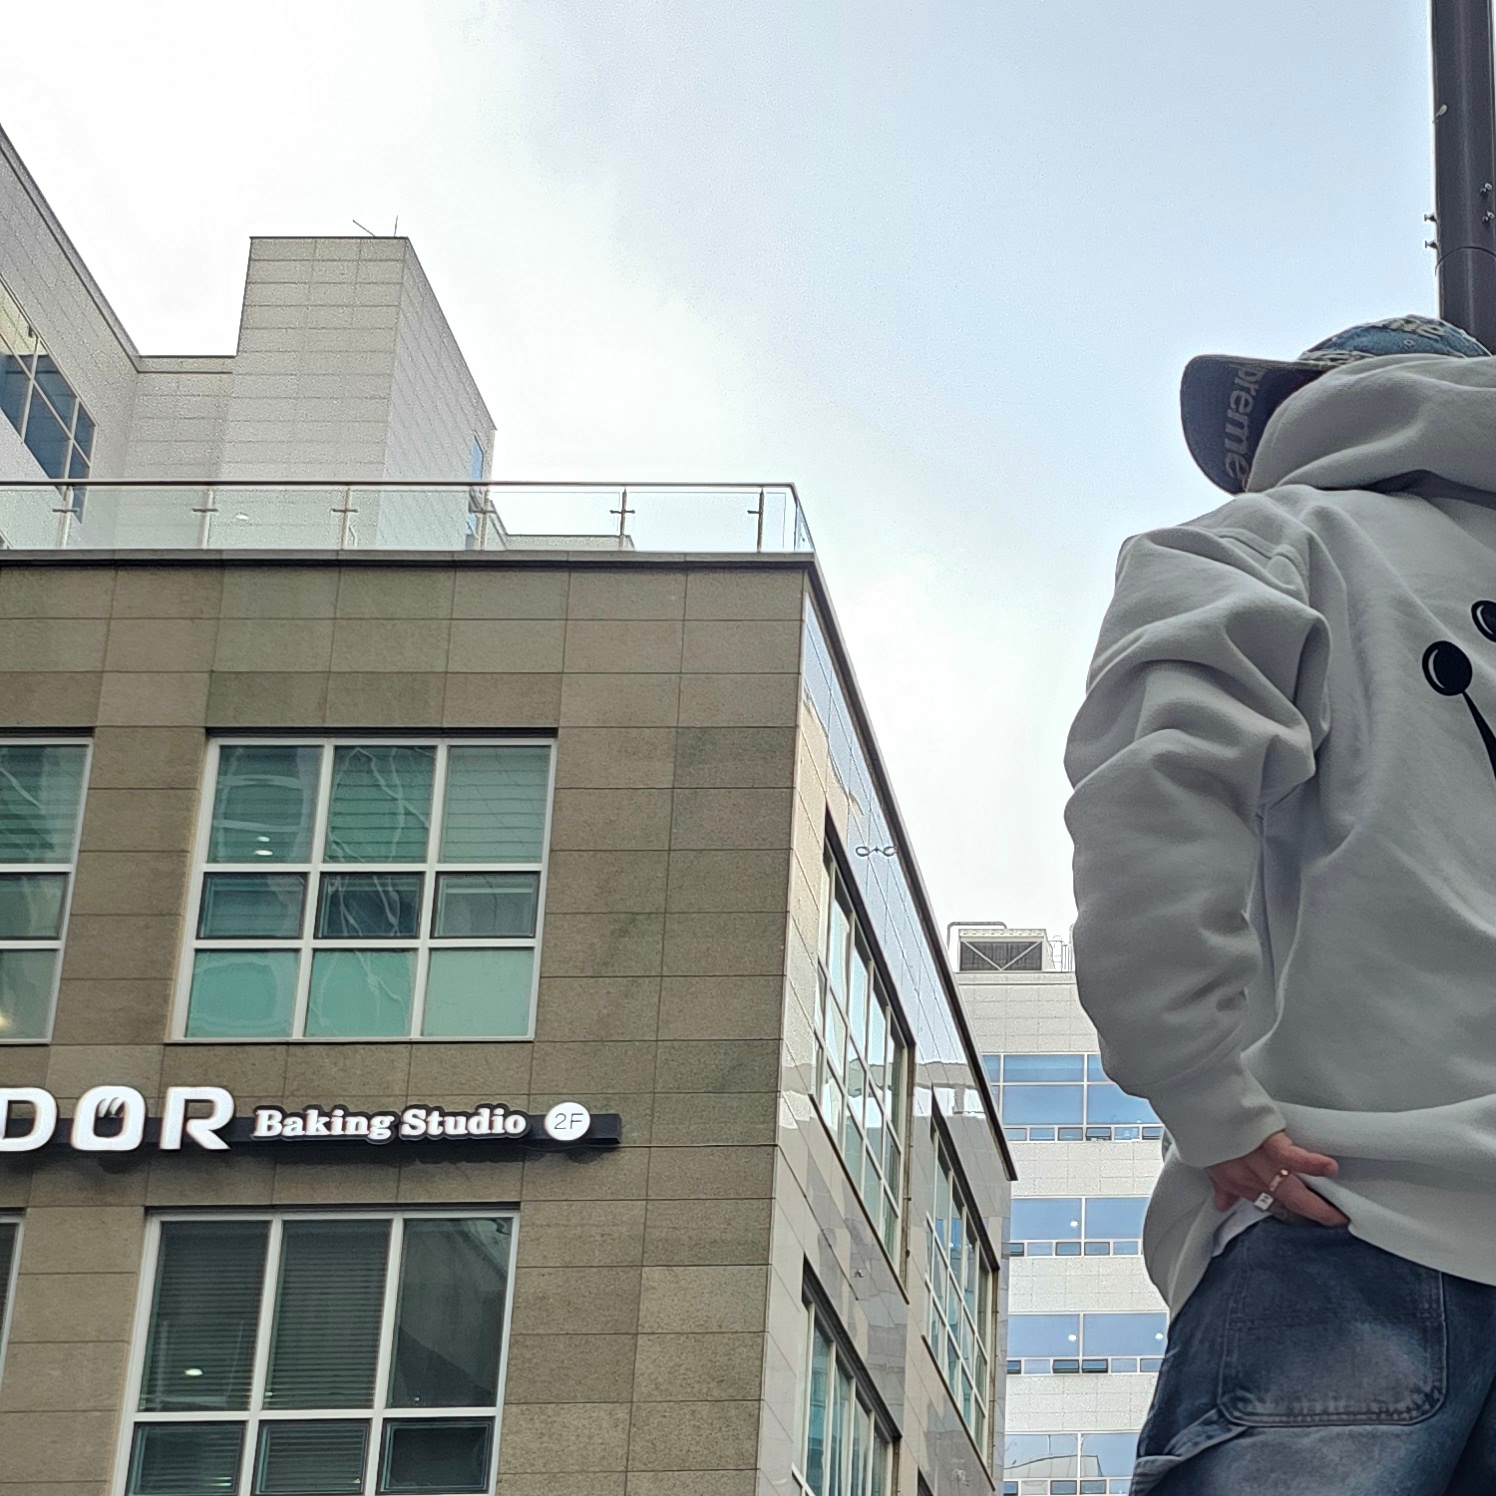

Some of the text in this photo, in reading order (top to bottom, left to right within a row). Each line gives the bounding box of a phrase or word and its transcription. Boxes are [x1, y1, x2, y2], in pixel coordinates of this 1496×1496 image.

[253, 1108, 394, 1140] Baking
[400, 1107, 527, 1137] Studio
[553, 1112, 585, 1131] 2F
